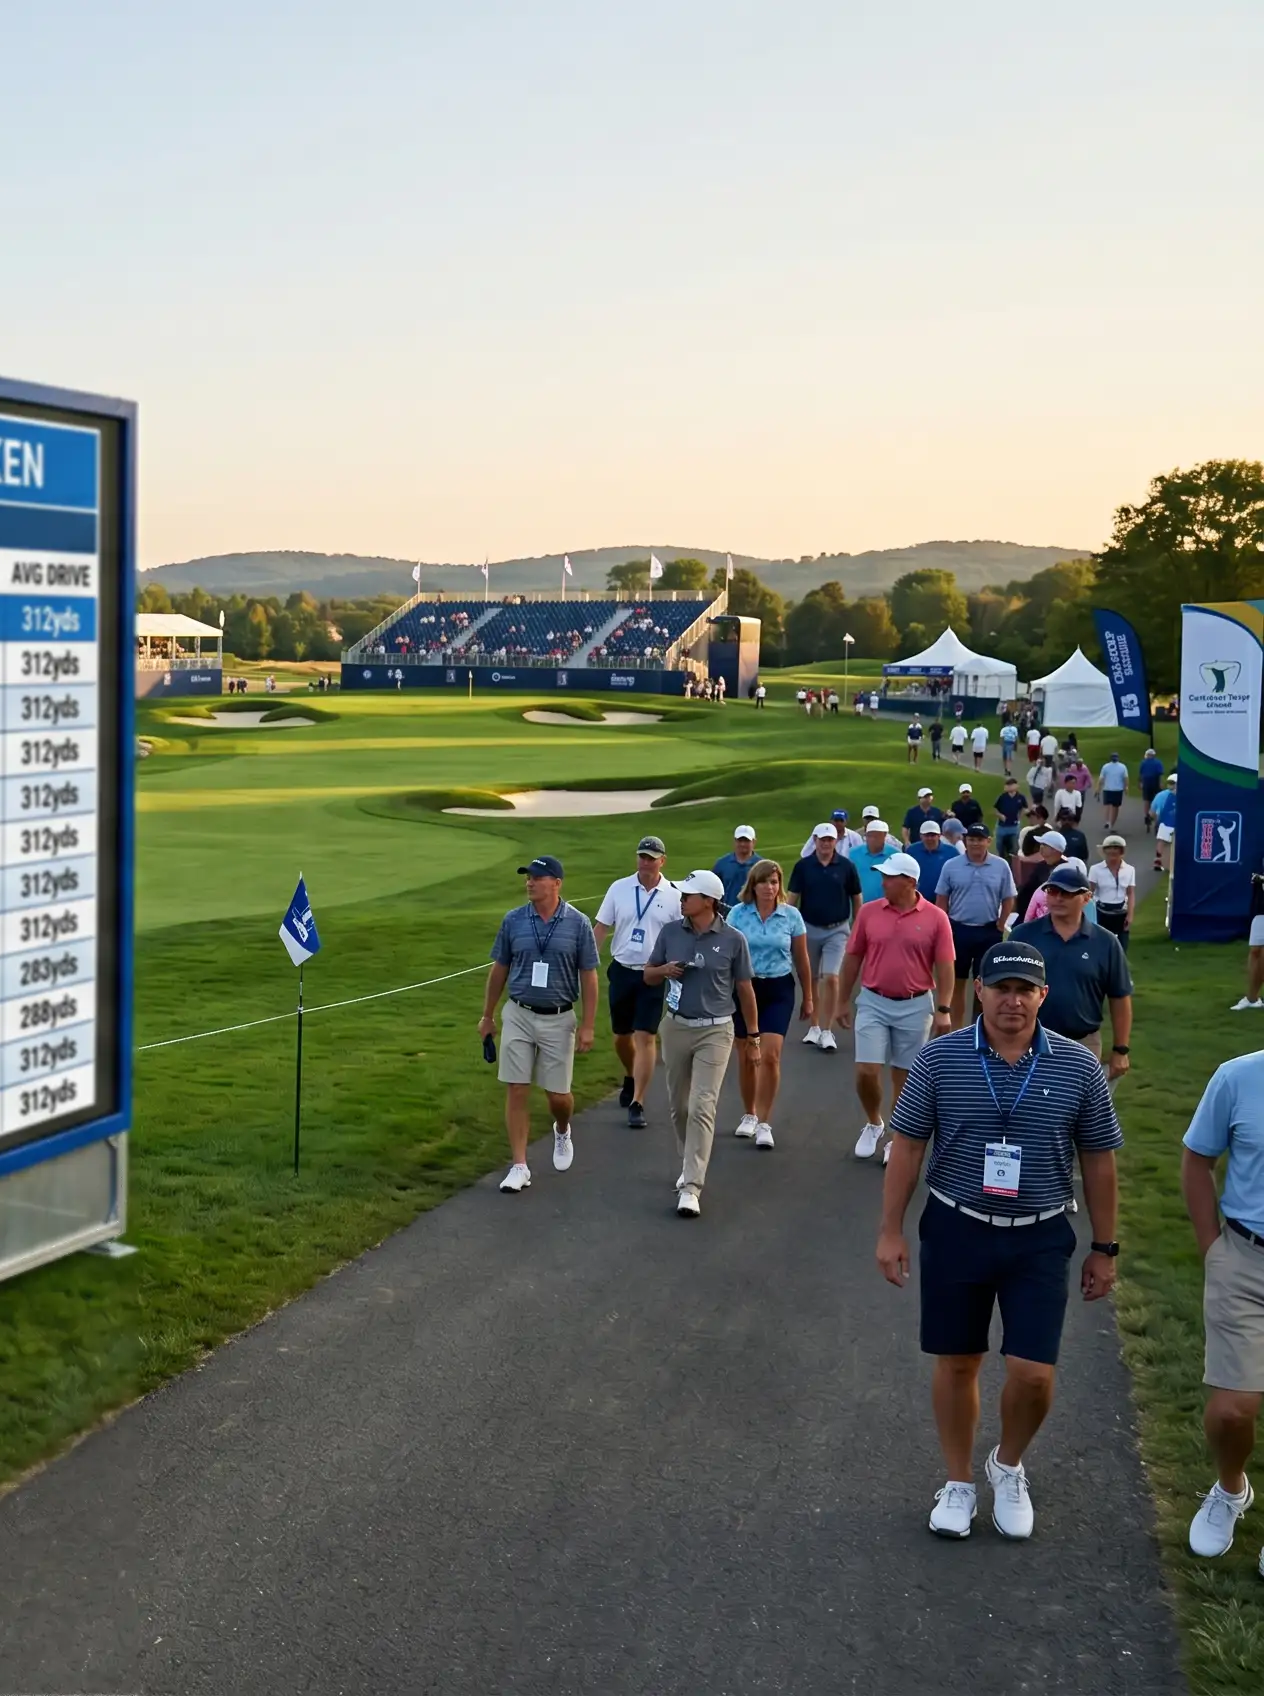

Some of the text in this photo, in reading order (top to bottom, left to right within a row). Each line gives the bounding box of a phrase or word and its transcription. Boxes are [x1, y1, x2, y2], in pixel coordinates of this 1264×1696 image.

[11, 562, 43, 586] AVG
[46, 563, 91, 588] DRIVE
[22, 605, 80, 638] 312yds
[21, 650, 80, 682] 312yds
[21, 694, 80, 726] 312yds
[21, 737, 80, 769] 312yds
[21, 781, 79, 813] 312yds
[20, 824, 79, 856] 312yds
[20, 867, 79, 899] 312yds
[20, 910, 78, 942] 312yds
[20, 1036, 78, 1071] 312yds
[19, 1078, 78, 1116] 312yds
